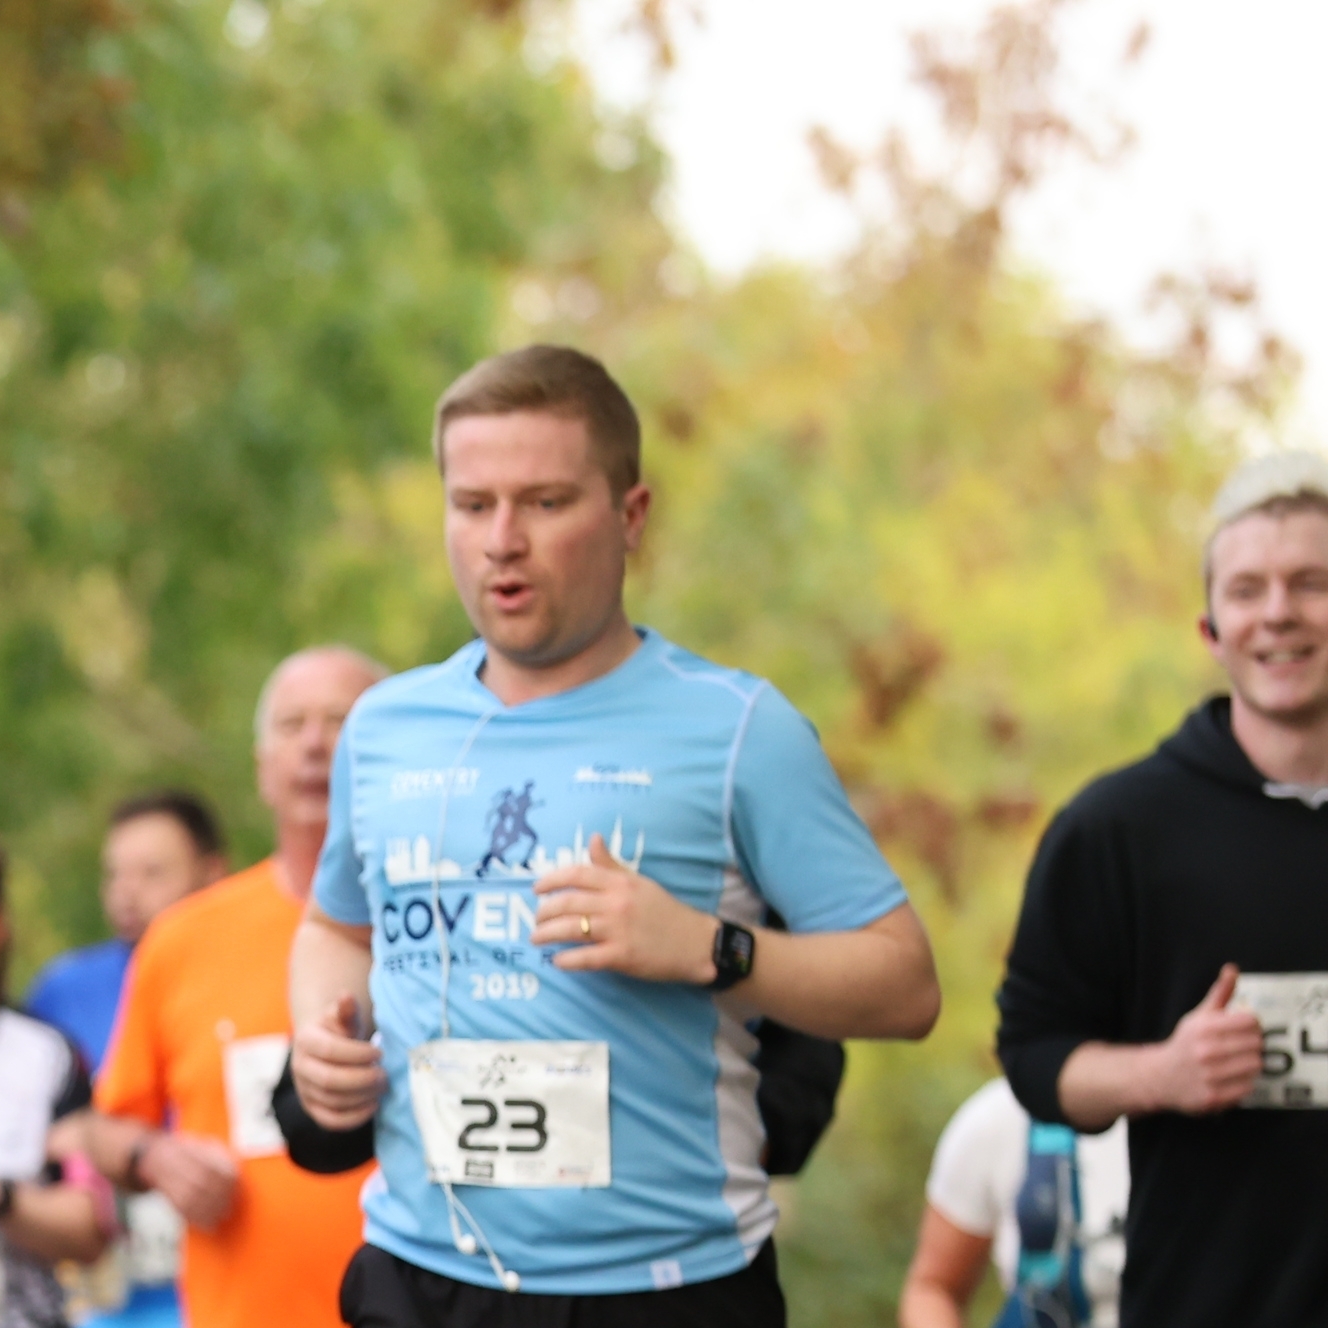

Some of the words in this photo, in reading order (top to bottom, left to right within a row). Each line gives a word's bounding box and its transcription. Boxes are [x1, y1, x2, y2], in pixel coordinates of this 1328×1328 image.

[382, 892, 537, 944] COVEN
[470, 972, 540, 1000] 2019
[458, 1099, 549, 1152] 23
